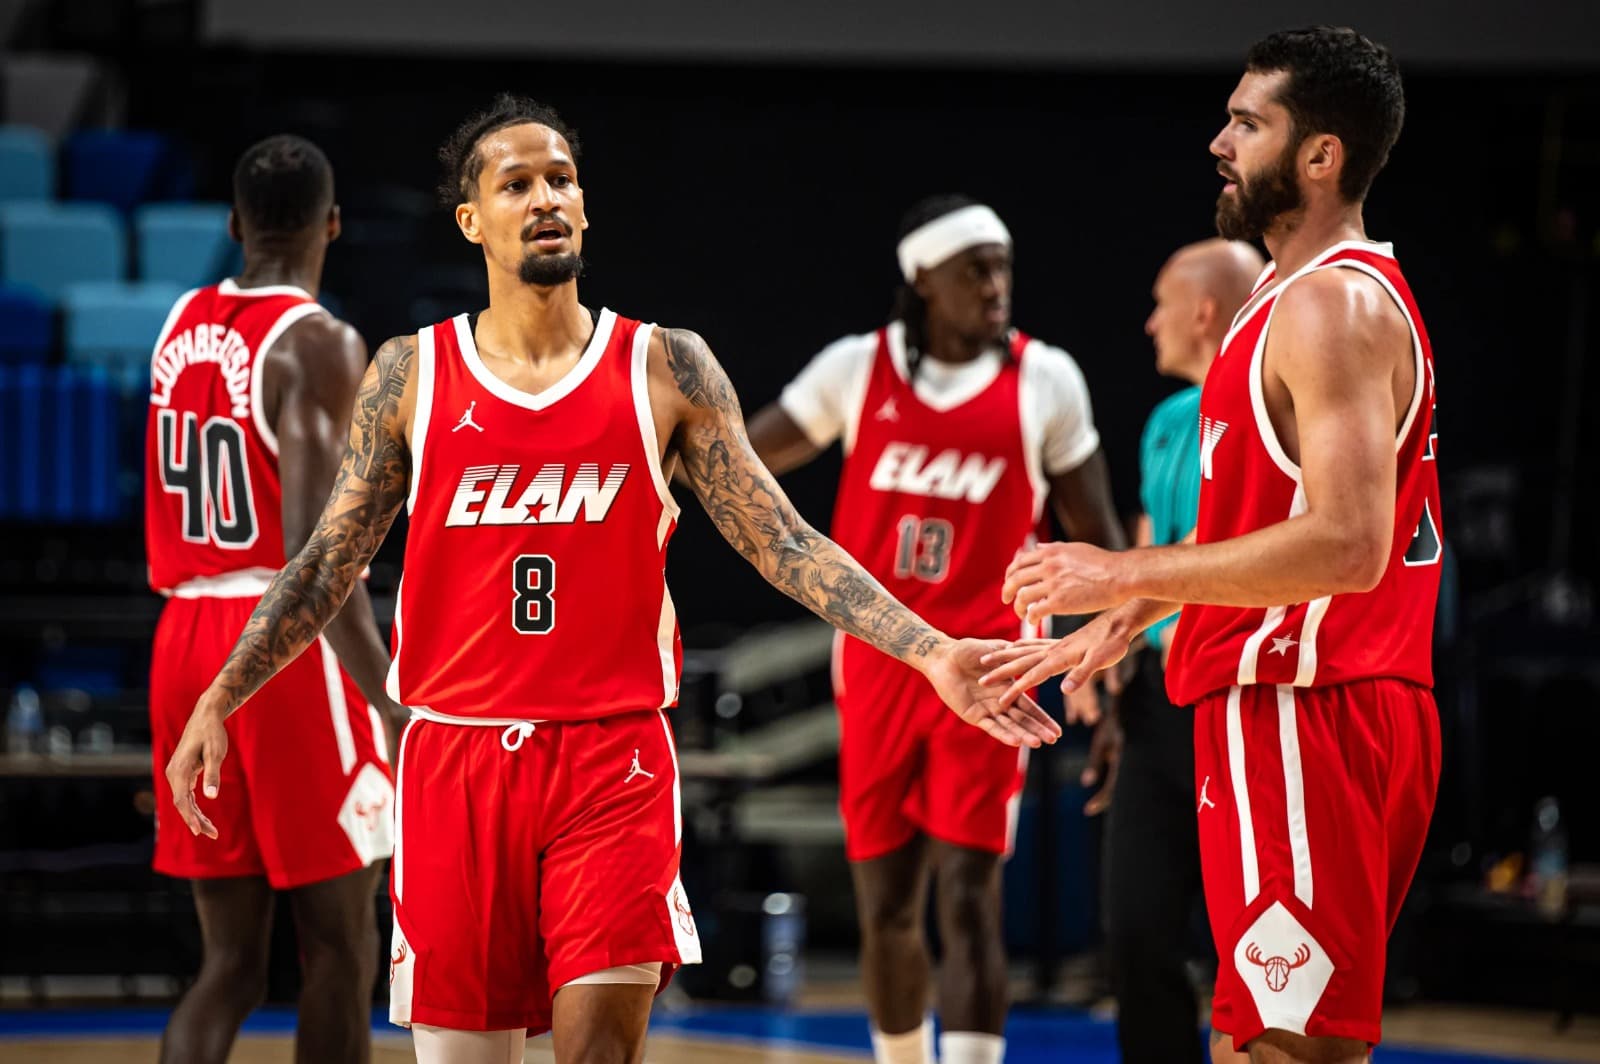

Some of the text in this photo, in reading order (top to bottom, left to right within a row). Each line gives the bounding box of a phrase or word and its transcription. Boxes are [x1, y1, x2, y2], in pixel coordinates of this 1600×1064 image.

[157, 408, 259, 550] 40
[445, 463, 631, 528] ELAN
[869, 440, 1008, 504] ELAN
[894, 514, 954, 584] 13
[512, 554, 556, 635] 8
